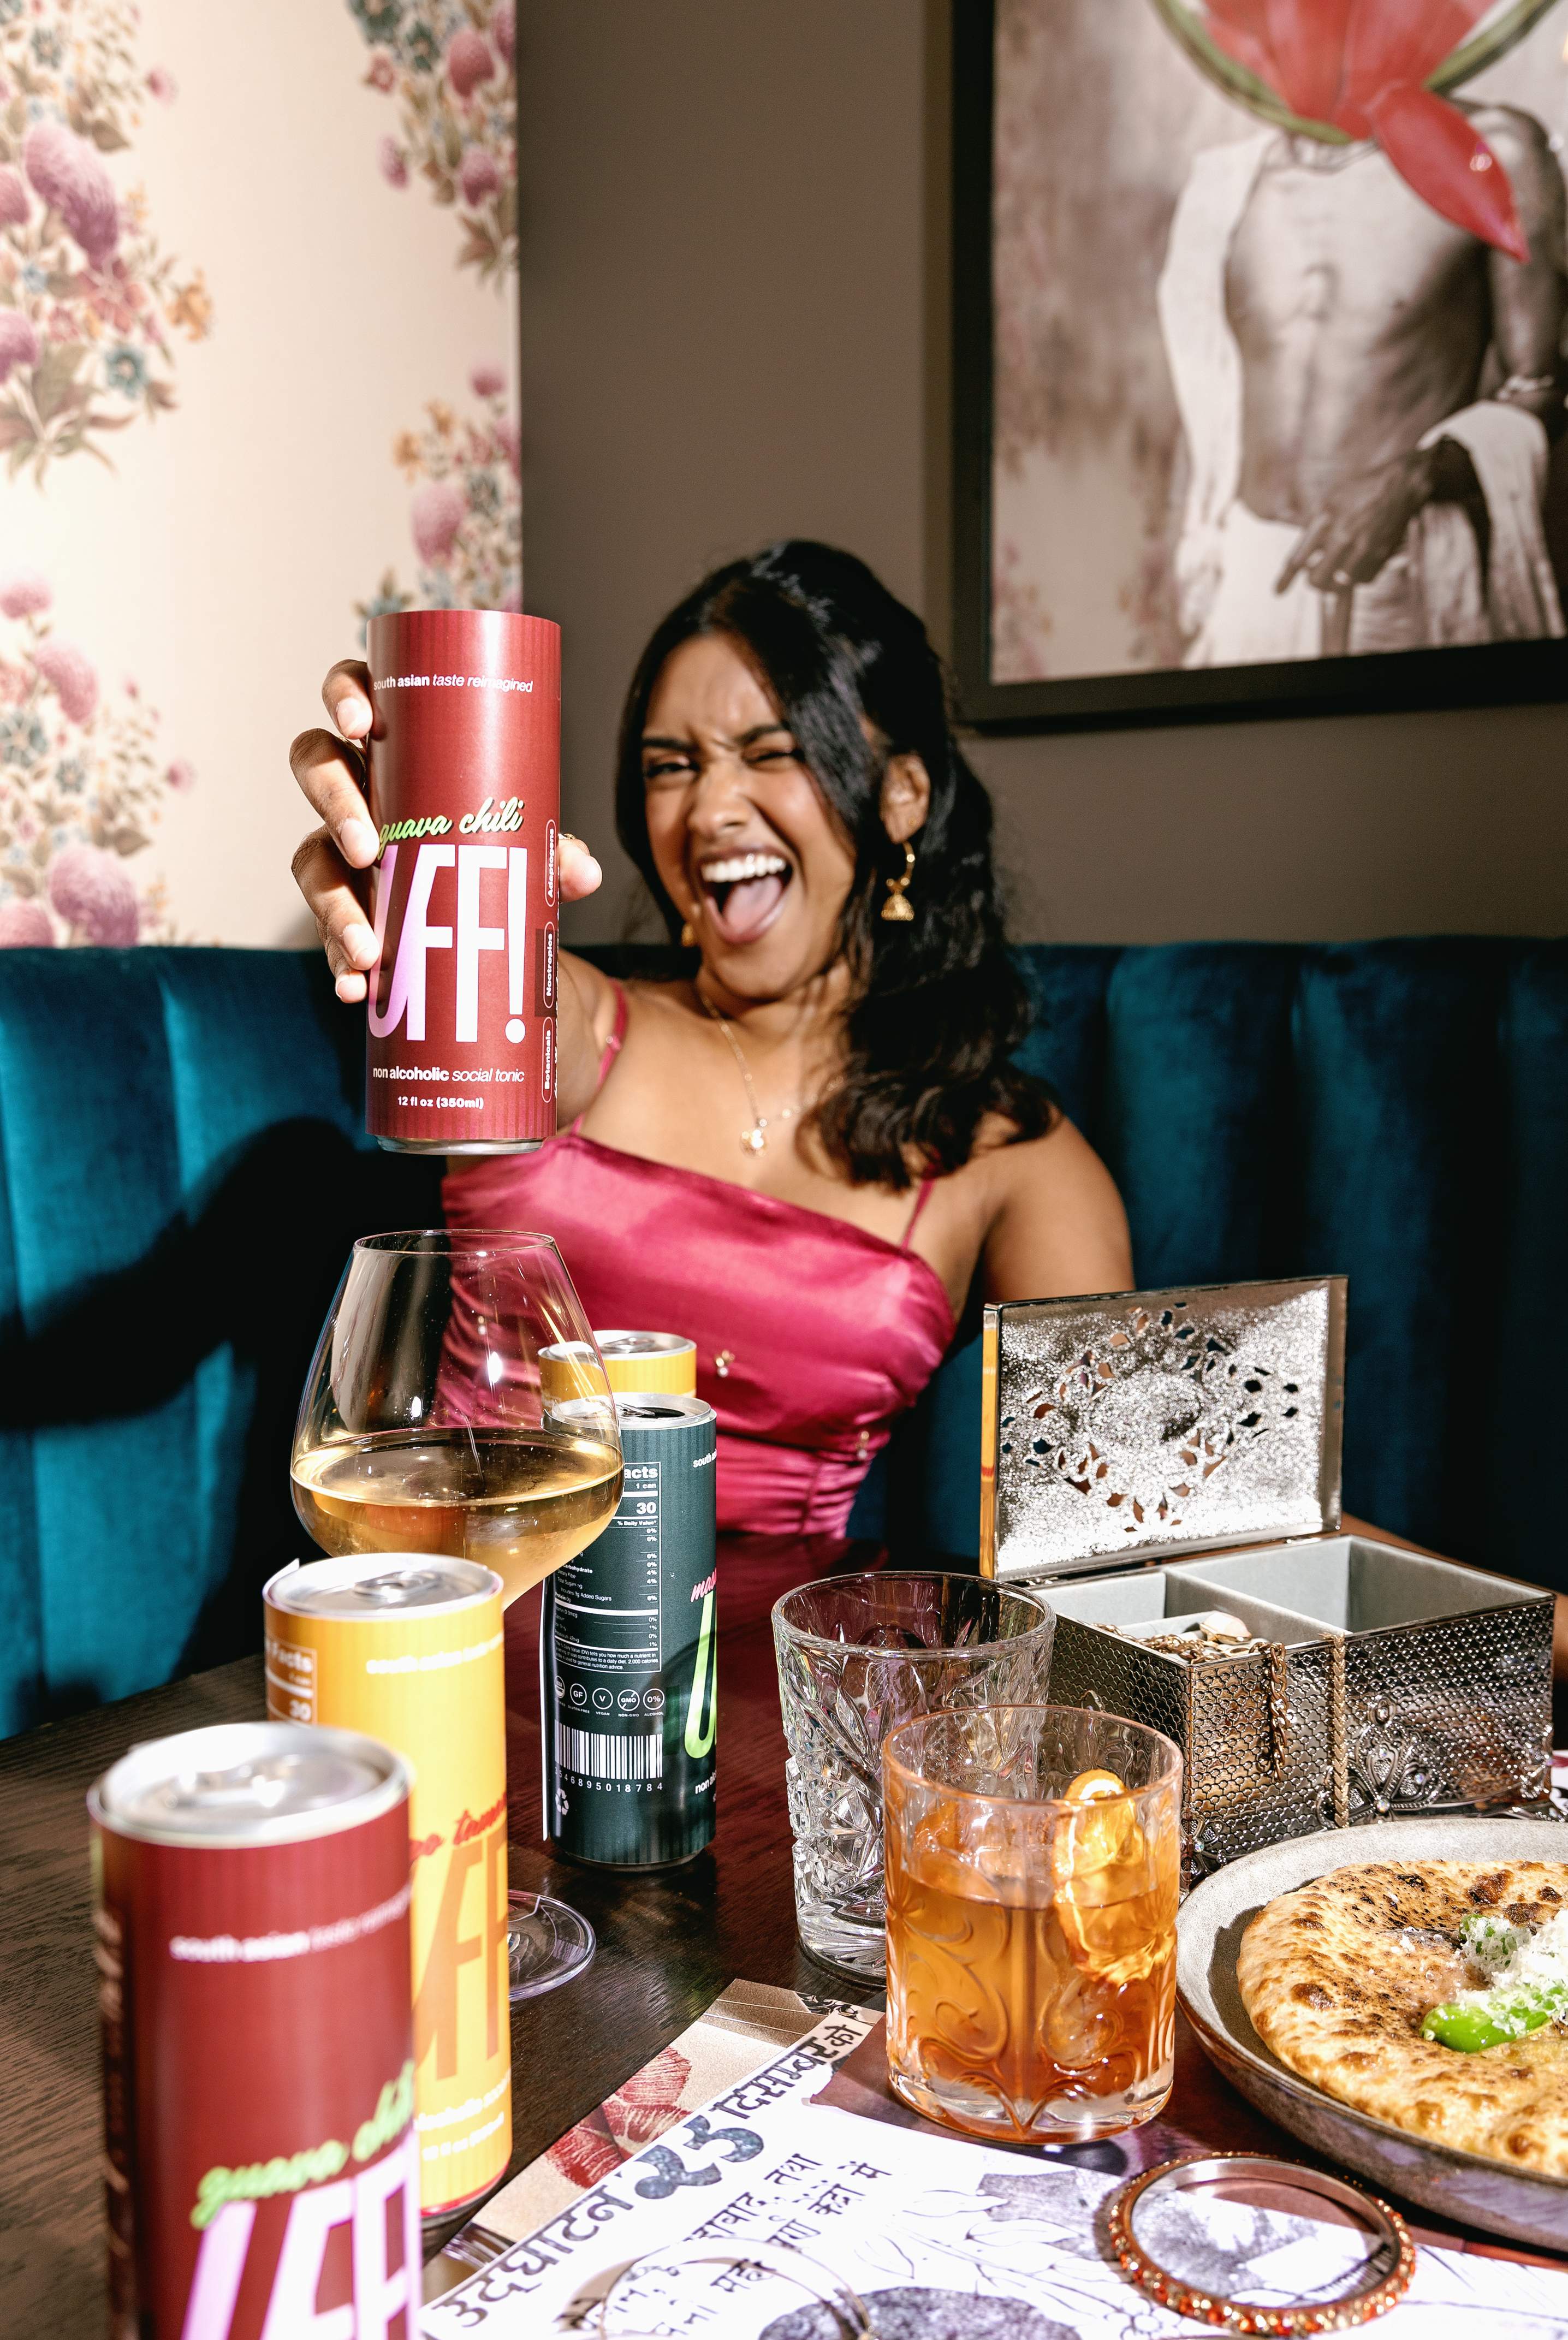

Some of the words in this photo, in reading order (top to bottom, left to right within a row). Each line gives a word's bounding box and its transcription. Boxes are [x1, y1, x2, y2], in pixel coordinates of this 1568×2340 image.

[373, 675, 396, 691] south
[397, 674, 430, 687] asian
[432, 674, 464, 687] taste
[467, 675, 533, 693] reimagined
[377, 815, 453, 860] guava
[459, 796, 525, 835] chili
[372, 1067, 389, 1079] non
[389, 1066, 450, 1082] alcoholic
[452, 1068, 494, 1083] social
[495, 1068, 525, 1083] tonic
[397, 1096, 408, 1106] 12
[411, 1096, 418, 1106] fl
[420, 1099, 433, 1107] oz
[436, 1096, 484, 1109] (350ml)
[693, 1453, 712, 1468] south
[623, 1466, 658, 1479] acts
[636, 1501, 657, 1515] 30
[573, 1690, 583, 1698] GF
[695, 1779, 710, 1795] non
